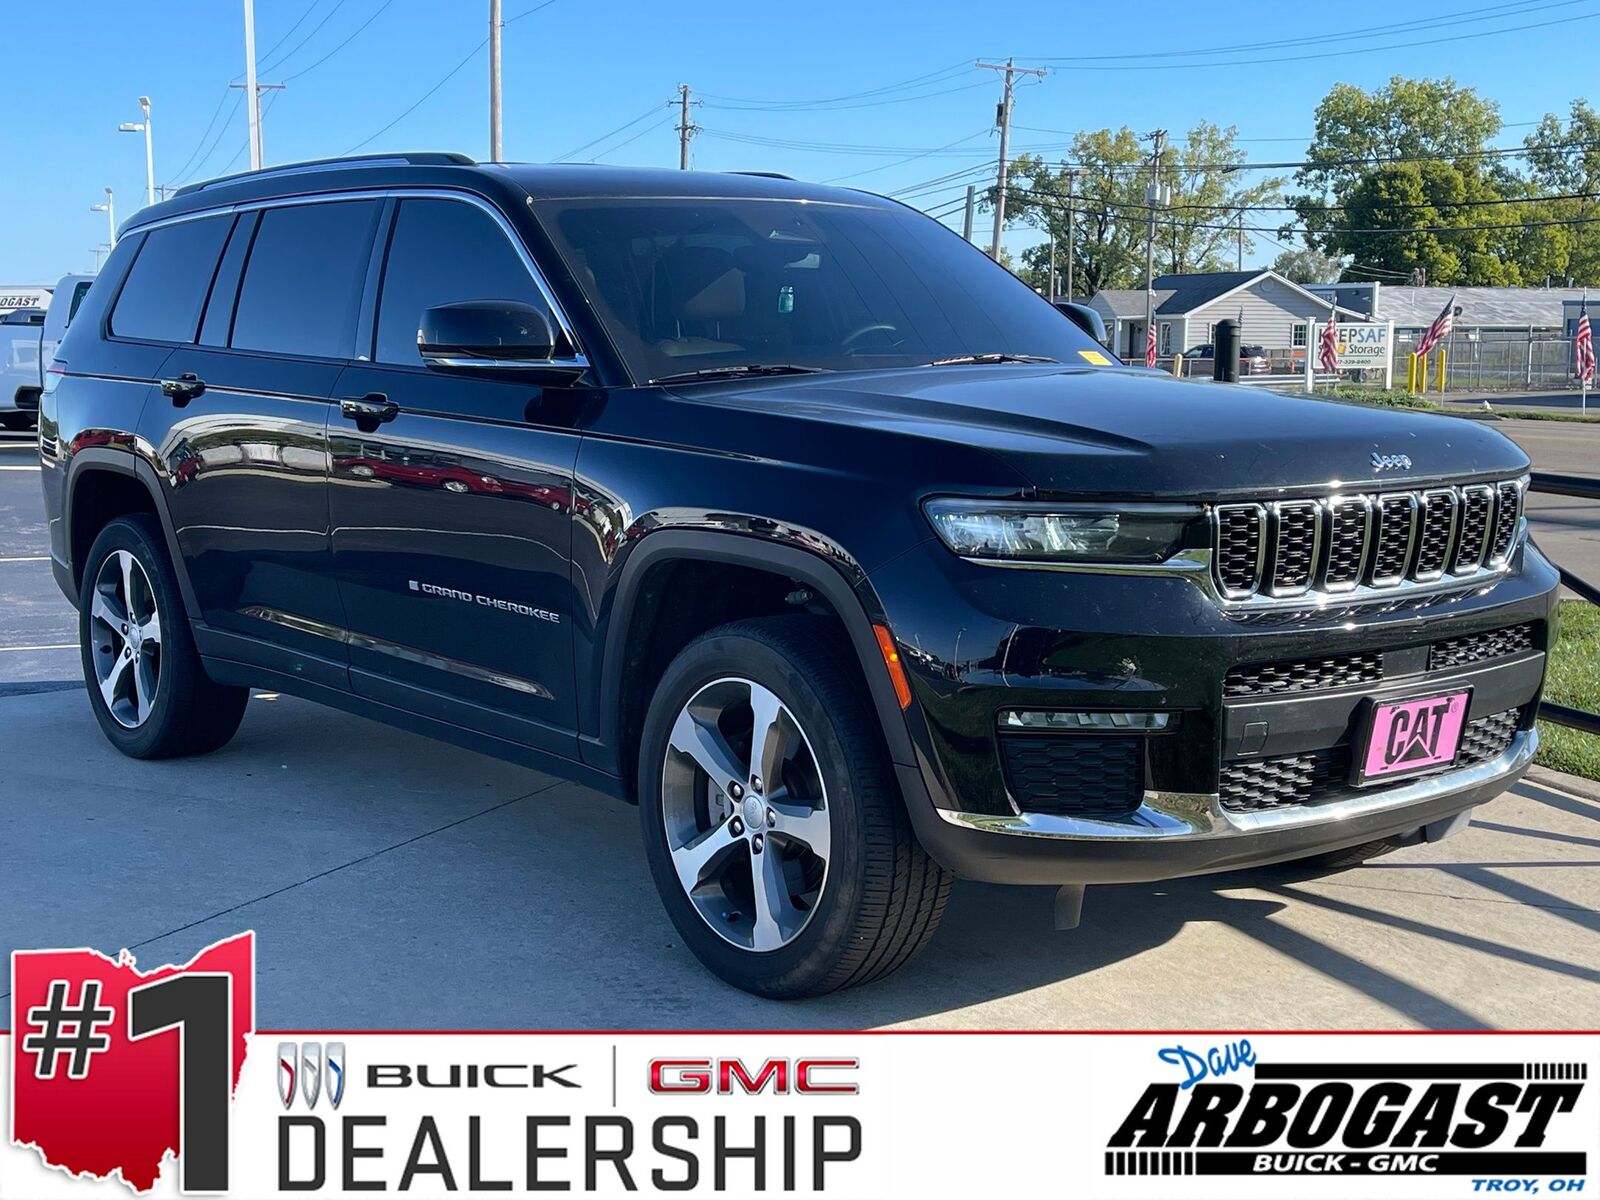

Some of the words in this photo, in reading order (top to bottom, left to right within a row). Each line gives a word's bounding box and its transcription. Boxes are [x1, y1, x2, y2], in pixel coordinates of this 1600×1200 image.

[1349, 343, 1386, 357] Storage
[1370, 452, 1412, 470] Jeep
[421, 583, 473, 602] GRAND
[476, 595, 560, 624] CHEROKEE
[1384, 703, 1450, 766] CAT
